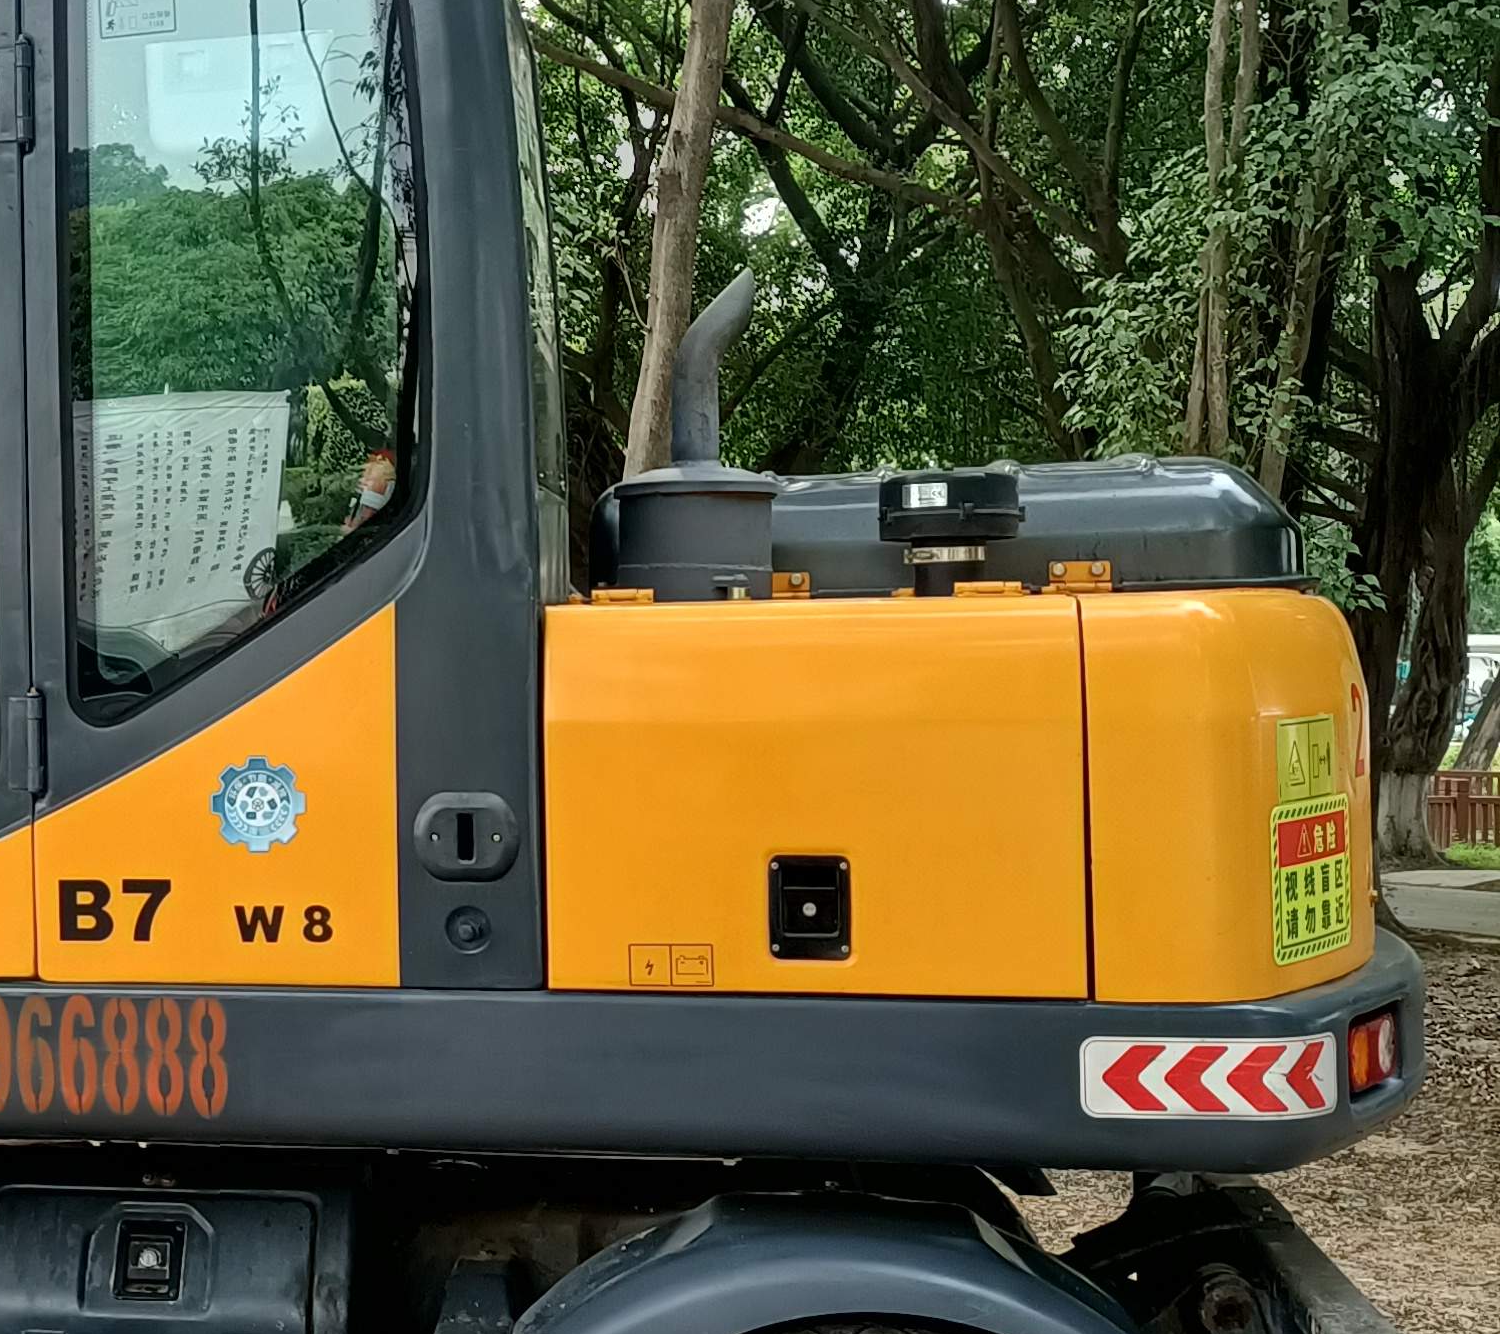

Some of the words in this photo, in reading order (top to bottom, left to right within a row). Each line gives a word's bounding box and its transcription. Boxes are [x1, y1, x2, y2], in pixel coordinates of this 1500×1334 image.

[1313, 819, 1337, 855] 危险
[1285, 859, 1344, 904] 视线盲区
[58, 879, 172, 942] B7
[1285, 895, 1344, 940] 请勿靠近
